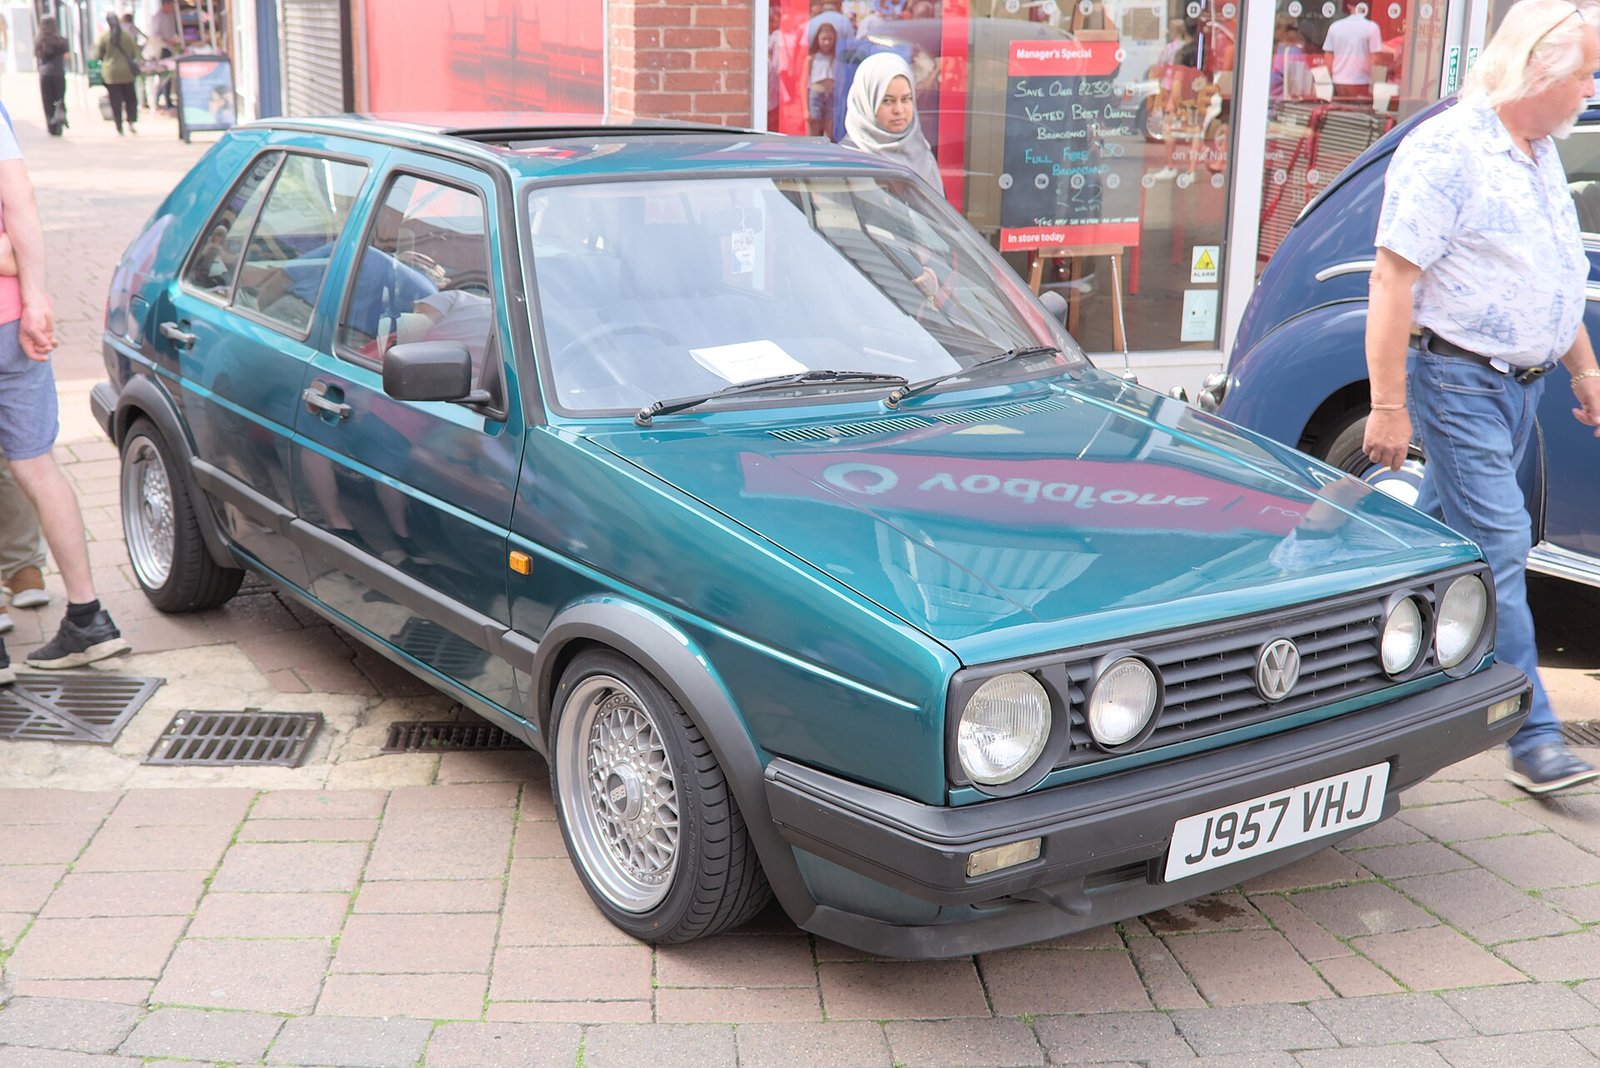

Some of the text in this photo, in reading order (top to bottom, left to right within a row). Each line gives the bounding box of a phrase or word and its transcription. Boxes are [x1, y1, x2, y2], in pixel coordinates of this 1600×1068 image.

[1016, 47, 1092, 61] Manager's Special
[1447, 57, 1458, 94] PUSH
[1172, 152, 1185, 161] on
[1008, 232, 1065, 243] In store today
[1185, 775, 1372, 865] J957 VHJ
